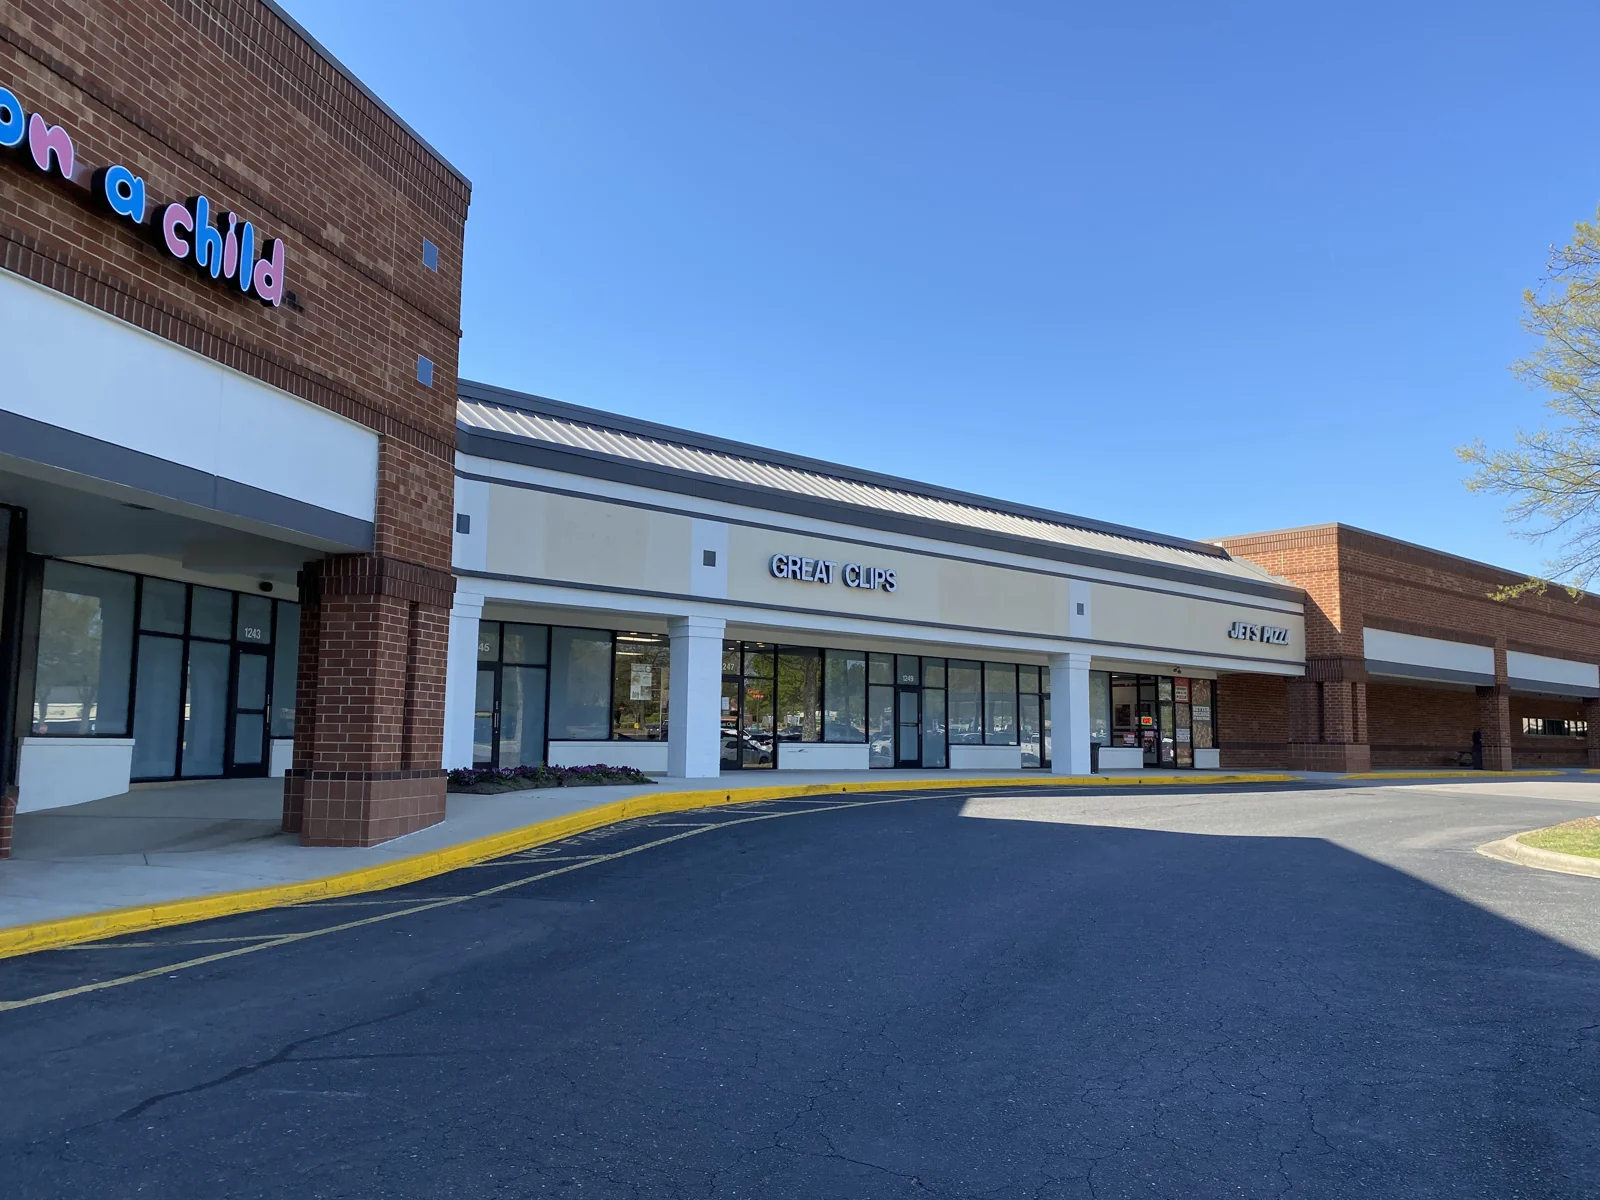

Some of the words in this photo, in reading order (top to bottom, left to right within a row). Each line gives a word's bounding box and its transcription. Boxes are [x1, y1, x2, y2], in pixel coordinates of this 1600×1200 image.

[104, 164, 146, 224] a
[163, 195, 285, 307] child
[769, 553, 838, 584] GREAT
[842, 563, 898, 593] CLIPS
[244, 627, 261, 640] 1243
[478, 642, 490, 652] 45
[722, 663, 735, 671] 247
[511, 846, 561, 858] NO
